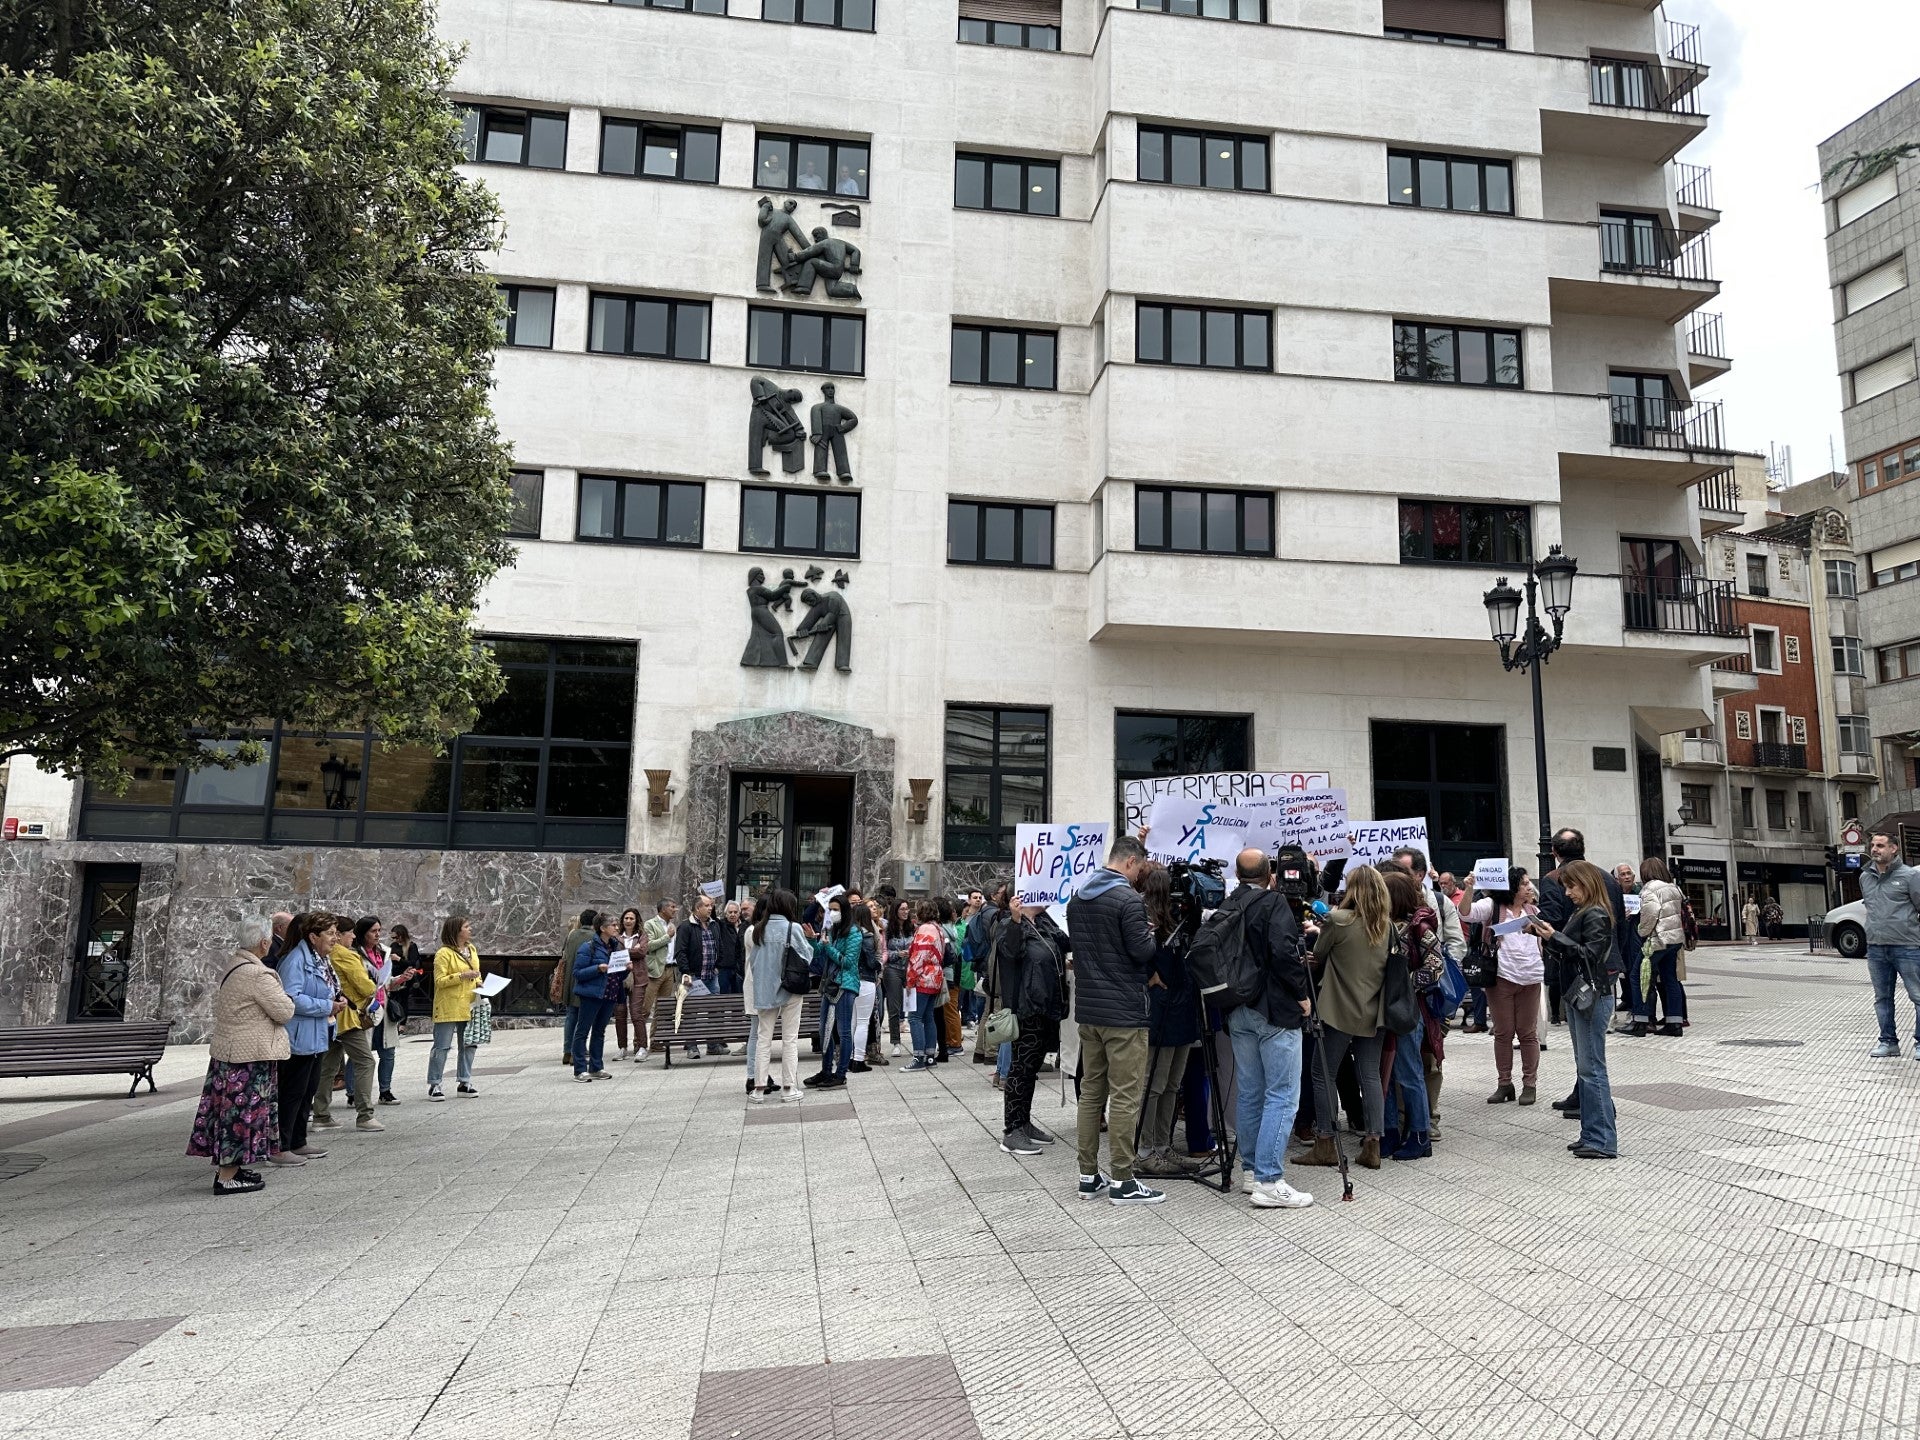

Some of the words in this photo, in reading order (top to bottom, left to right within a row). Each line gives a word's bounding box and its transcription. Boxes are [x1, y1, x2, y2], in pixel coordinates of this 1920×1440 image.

[1260, 820, 1272, 828] EN
[1315, 813, 1336, 821] ROTO
[1037, 832, 1054, 846] EL
[1060, 825, 1103, 852] SESPA
[1318, 835, 1327, 843] LA
[1310, 846, 1344, 858] ALARIO
[1019, 842, 1044, 877] NO
[1050, 850, 1096, 878] PAGA
